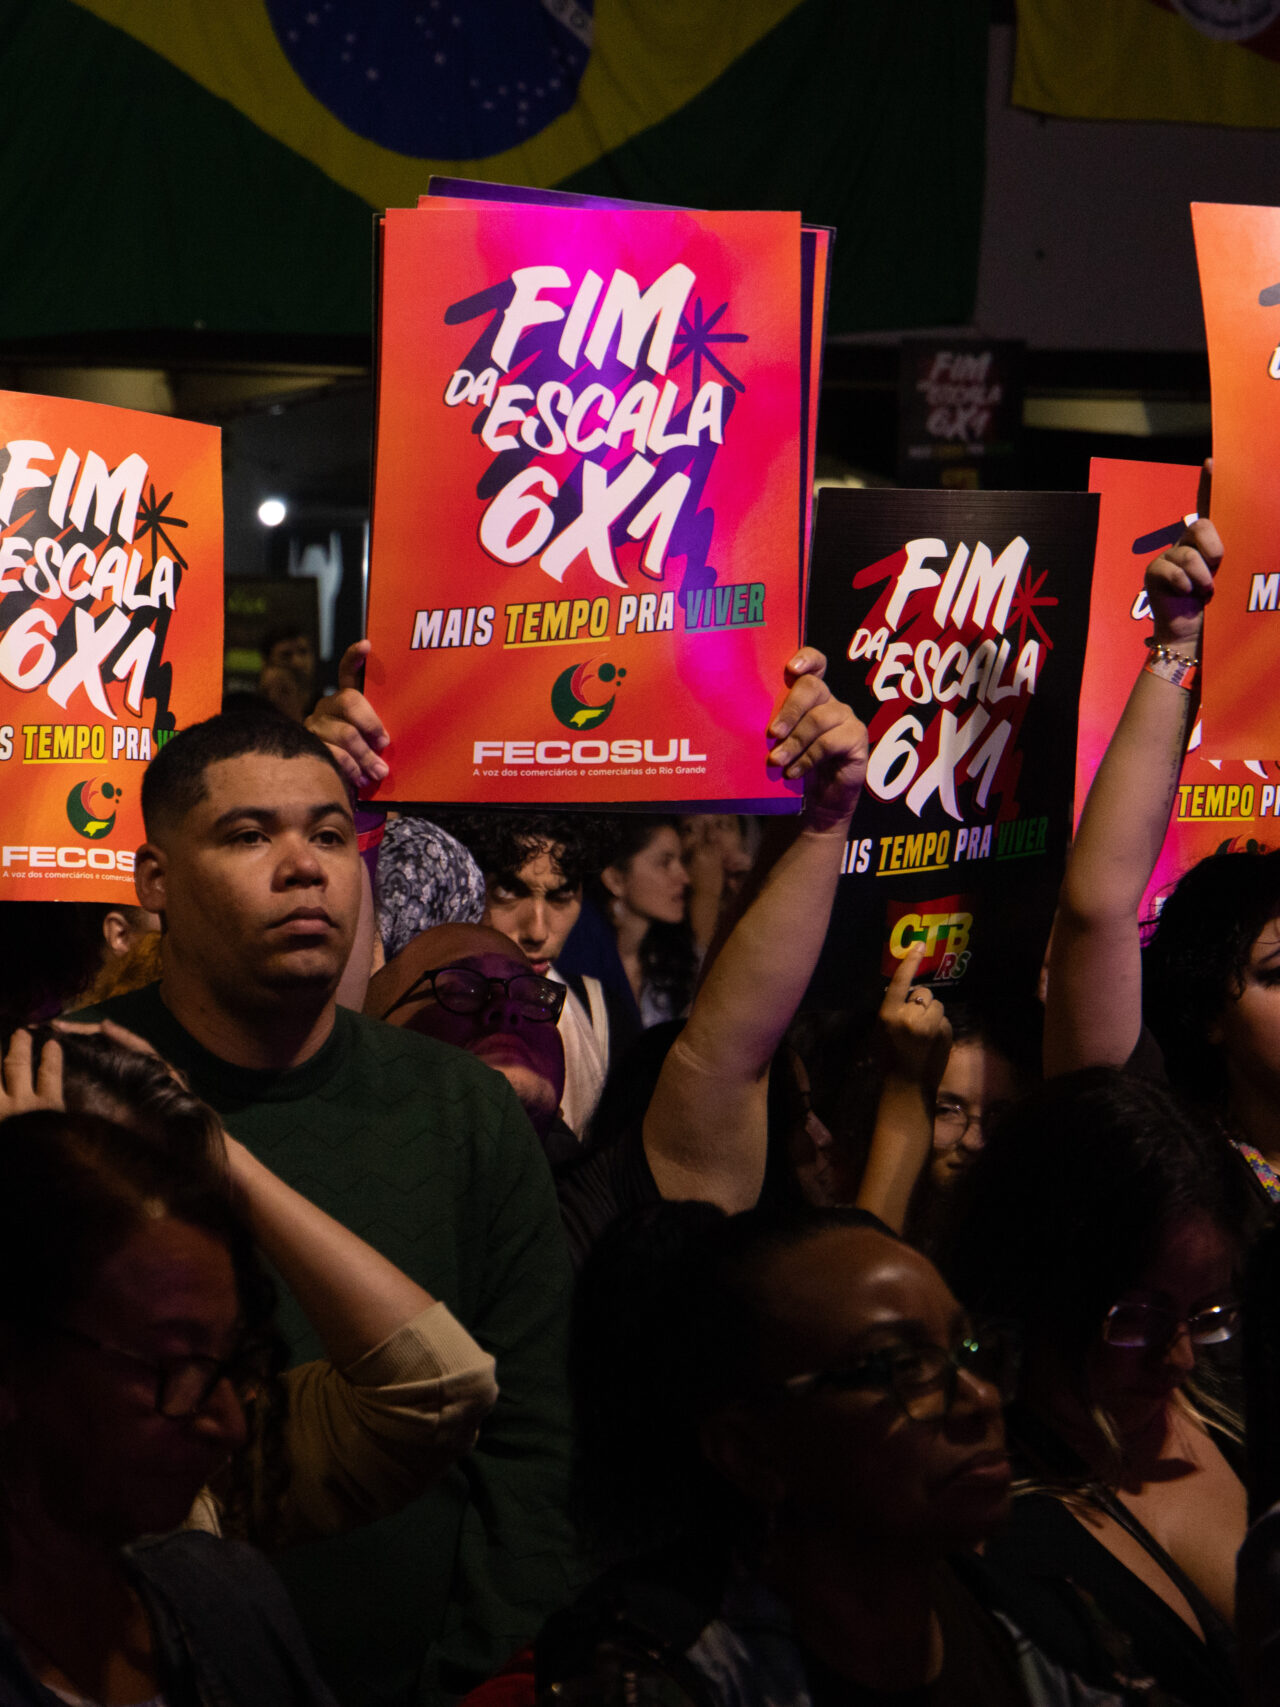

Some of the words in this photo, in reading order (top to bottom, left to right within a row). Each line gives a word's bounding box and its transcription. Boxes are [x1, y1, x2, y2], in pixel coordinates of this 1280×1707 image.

[491, 262, 697, 376] FIM
[444, 367, 499, 407] DA
[481, 379, 725, 456] ESCALA
[479, 459, 692, 589] 6X1
[884, 535, 1030, 635] FIM
[411, 606, 494, 651] MAIS
[504, 597, 611, 645] TEMPO
[617, 592, 675, 635] PRA
[685, 583, 767, 629] VIVER
[849, 627, 889, 661] DA
[872, 639, 1039, 706] ESCALA
[22, 725, 106, 761] TEMPO
[111, 726, 151, 761] PRA
[472, 738, 708, 764] FECOSUL
[866, 705, 1012, 822] 6X1
[473, 768, 480, 776] A
[483, 769, 499, 777] voz
[501, 768, 518, 777] dos
[520, 768, 578, 777] comerciários
[587, 766, 643, 776] comerciárias
[645, 766, 657, 775] do
[659, 765, 673, 775] Rio
[675, 765, 707, 775] Grande
[1178, 784, 1255, 818] TEMPO
[2, 846, 136, 872] FECOS
[878, 829, 951, 871] TEMPO
[953, 824, 993, 862] PRA
[996, 816, 1049, 857] VIVER
[3, 870, 9, 878] A
[28, 871, 43, 879] dos
[44, 871, 94, 880] comerciários
[101, 874, 136, 883] comerciári
[889, 912, 974, 960] CTB
[933, 950, 973, 980] RS
